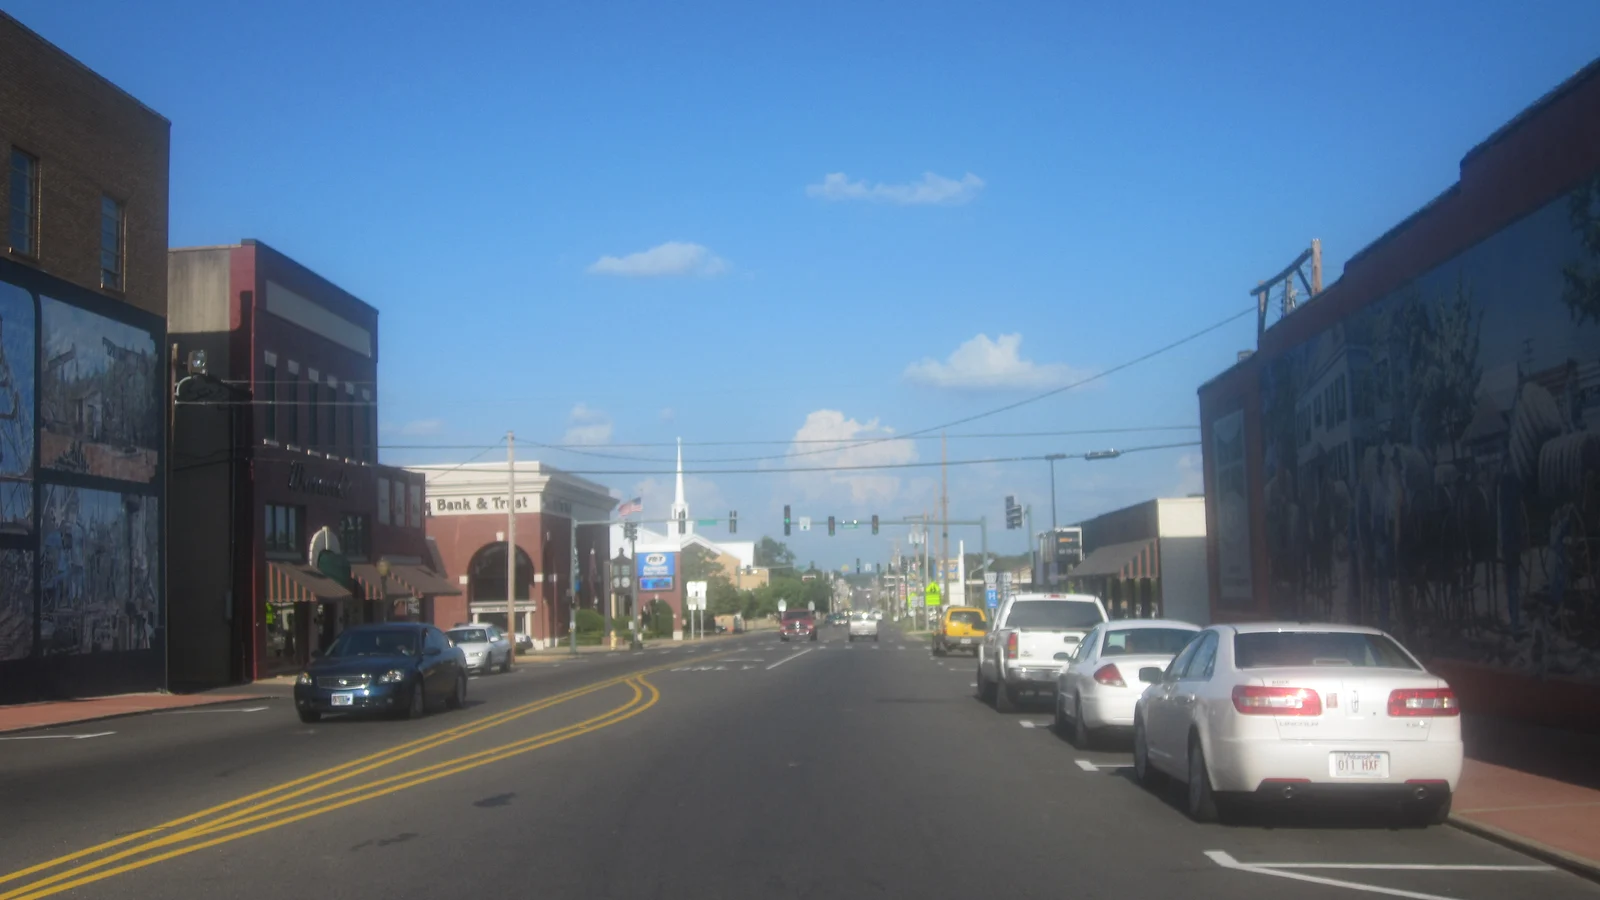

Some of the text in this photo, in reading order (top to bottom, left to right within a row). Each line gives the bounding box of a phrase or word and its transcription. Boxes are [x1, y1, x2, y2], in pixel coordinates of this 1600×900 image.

[437, 498, 471, 511] Bank
[476, 497, 487, 510] &
[492, 496, 527, 509] Trst
[988, 591, 996, 600] H
